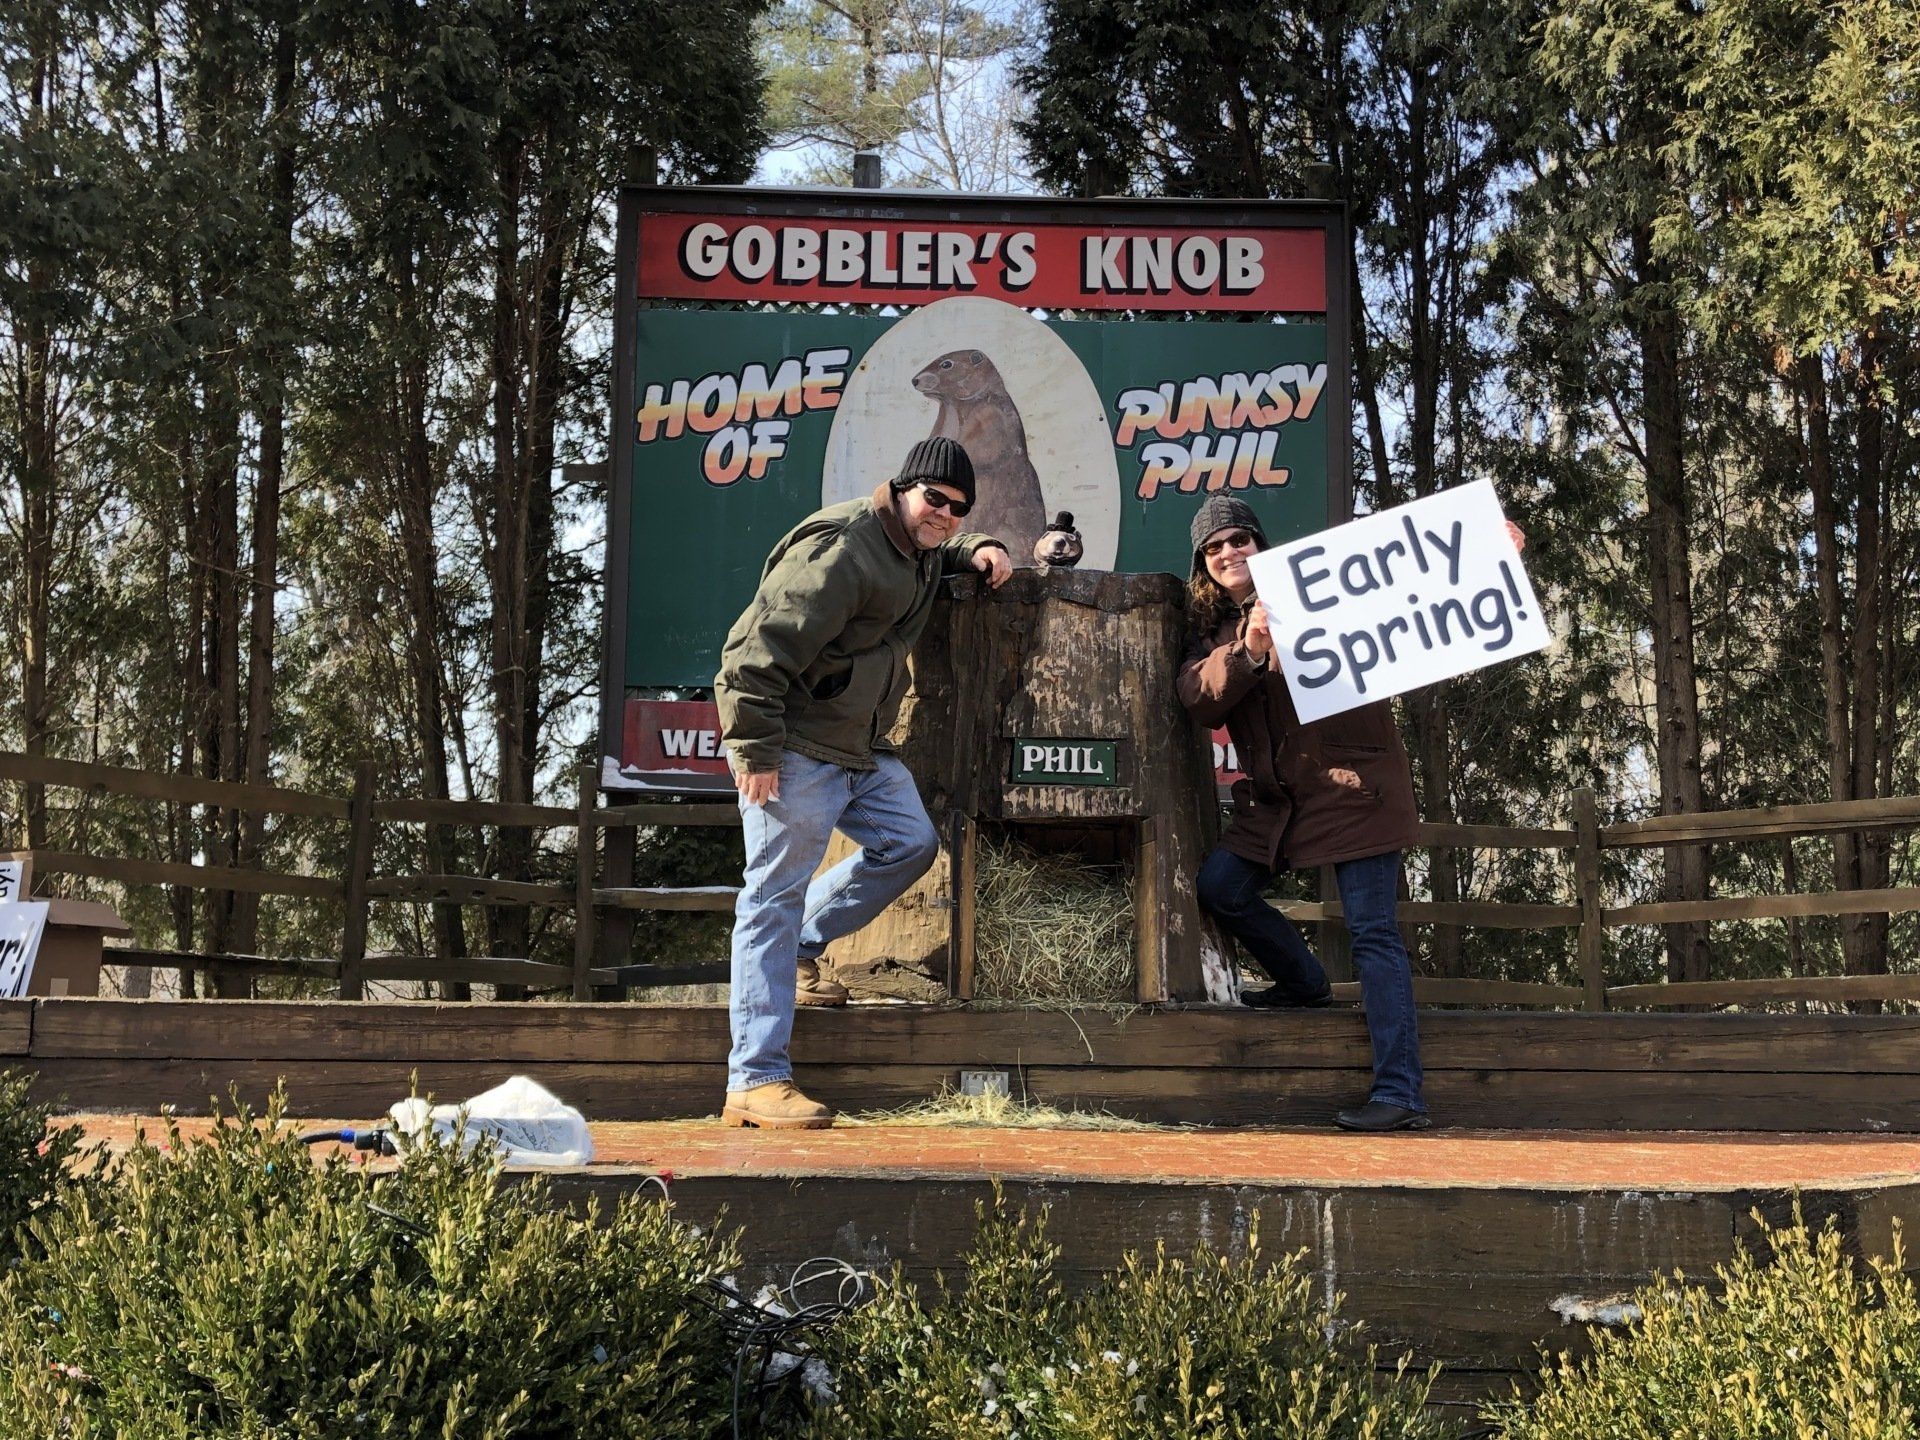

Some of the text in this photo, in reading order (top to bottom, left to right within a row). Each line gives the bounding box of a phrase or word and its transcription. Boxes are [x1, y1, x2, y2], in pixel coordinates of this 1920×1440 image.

[680, 222, 1265, 296] GOBBLER'S KNOB
[637, 347, 851, 443] HOME
[1114, 362, 1327, 447] PUNXSY
[703, 419, 792, 485] OF
[1138, 429, 1290, 500] PHIL
[1287, 514, 1462, 613] Early
[1293, 559, 1528, 695] Spring!
[1022, 745, 1104, 774] PHIL
